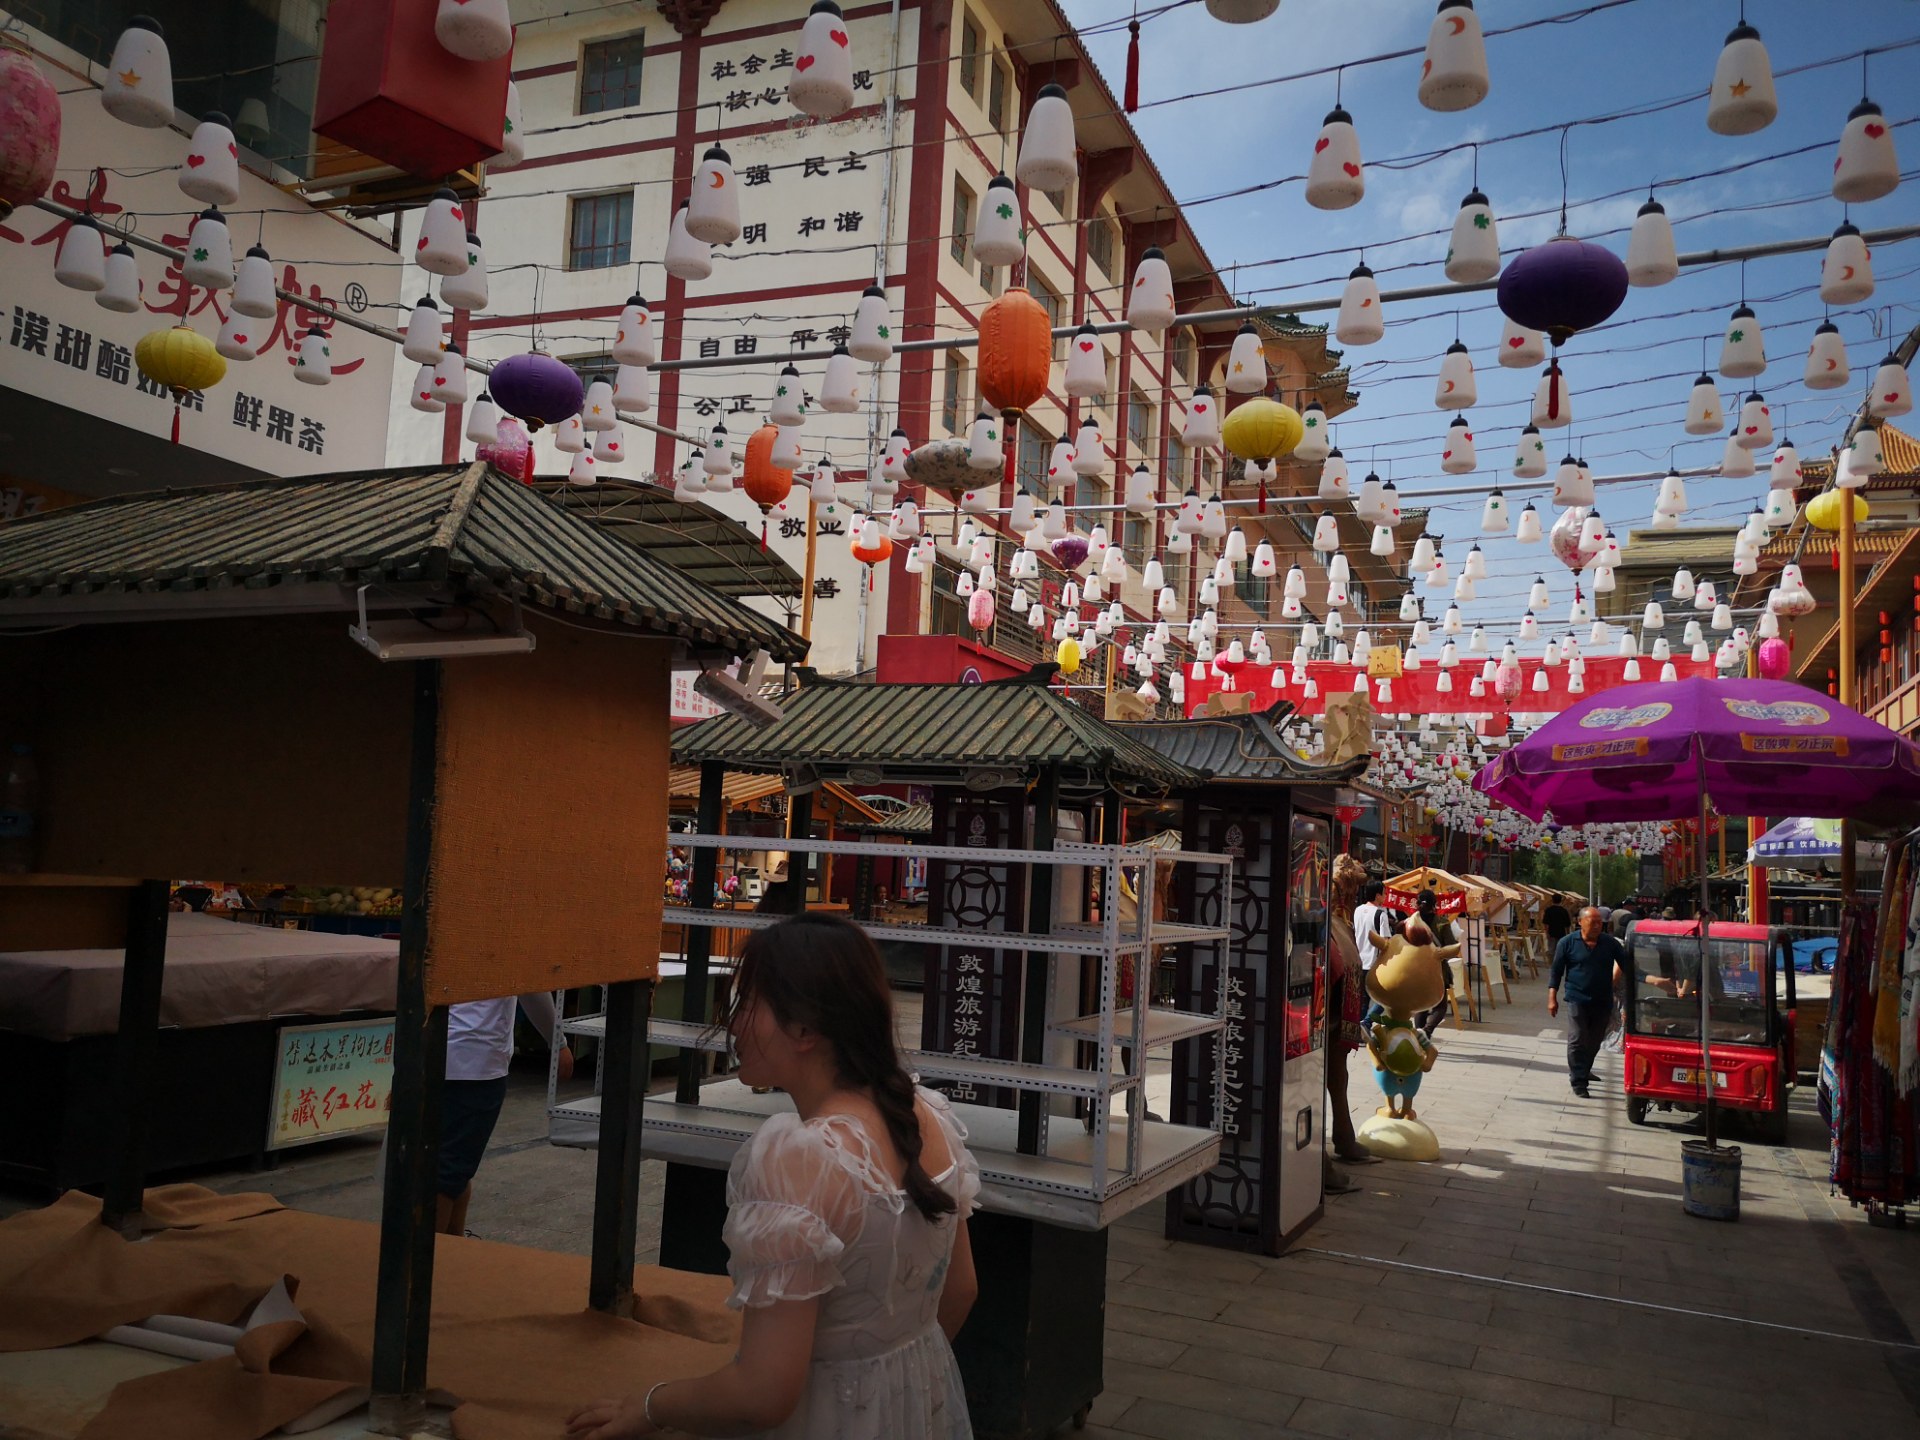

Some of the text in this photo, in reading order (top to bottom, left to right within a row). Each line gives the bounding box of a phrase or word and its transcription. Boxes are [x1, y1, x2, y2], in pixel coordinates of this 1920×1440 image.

[802, 151, 867, 177] 民主
[798, 211, 863, 237] 和谐
[700, 326, 852, 358] 自由 平等
[694, 394, 755, 416] 公正
[233, 391, 326, 456] 鲜果茶
[779, 517, 845, 538] 敬业
[1753, 737, 1834, 750] 这酸爽 才正宗
[951, 954, 985, 1101] 敦煌旅游纪品
[291, 1079, 377, 1129] 藏红花
